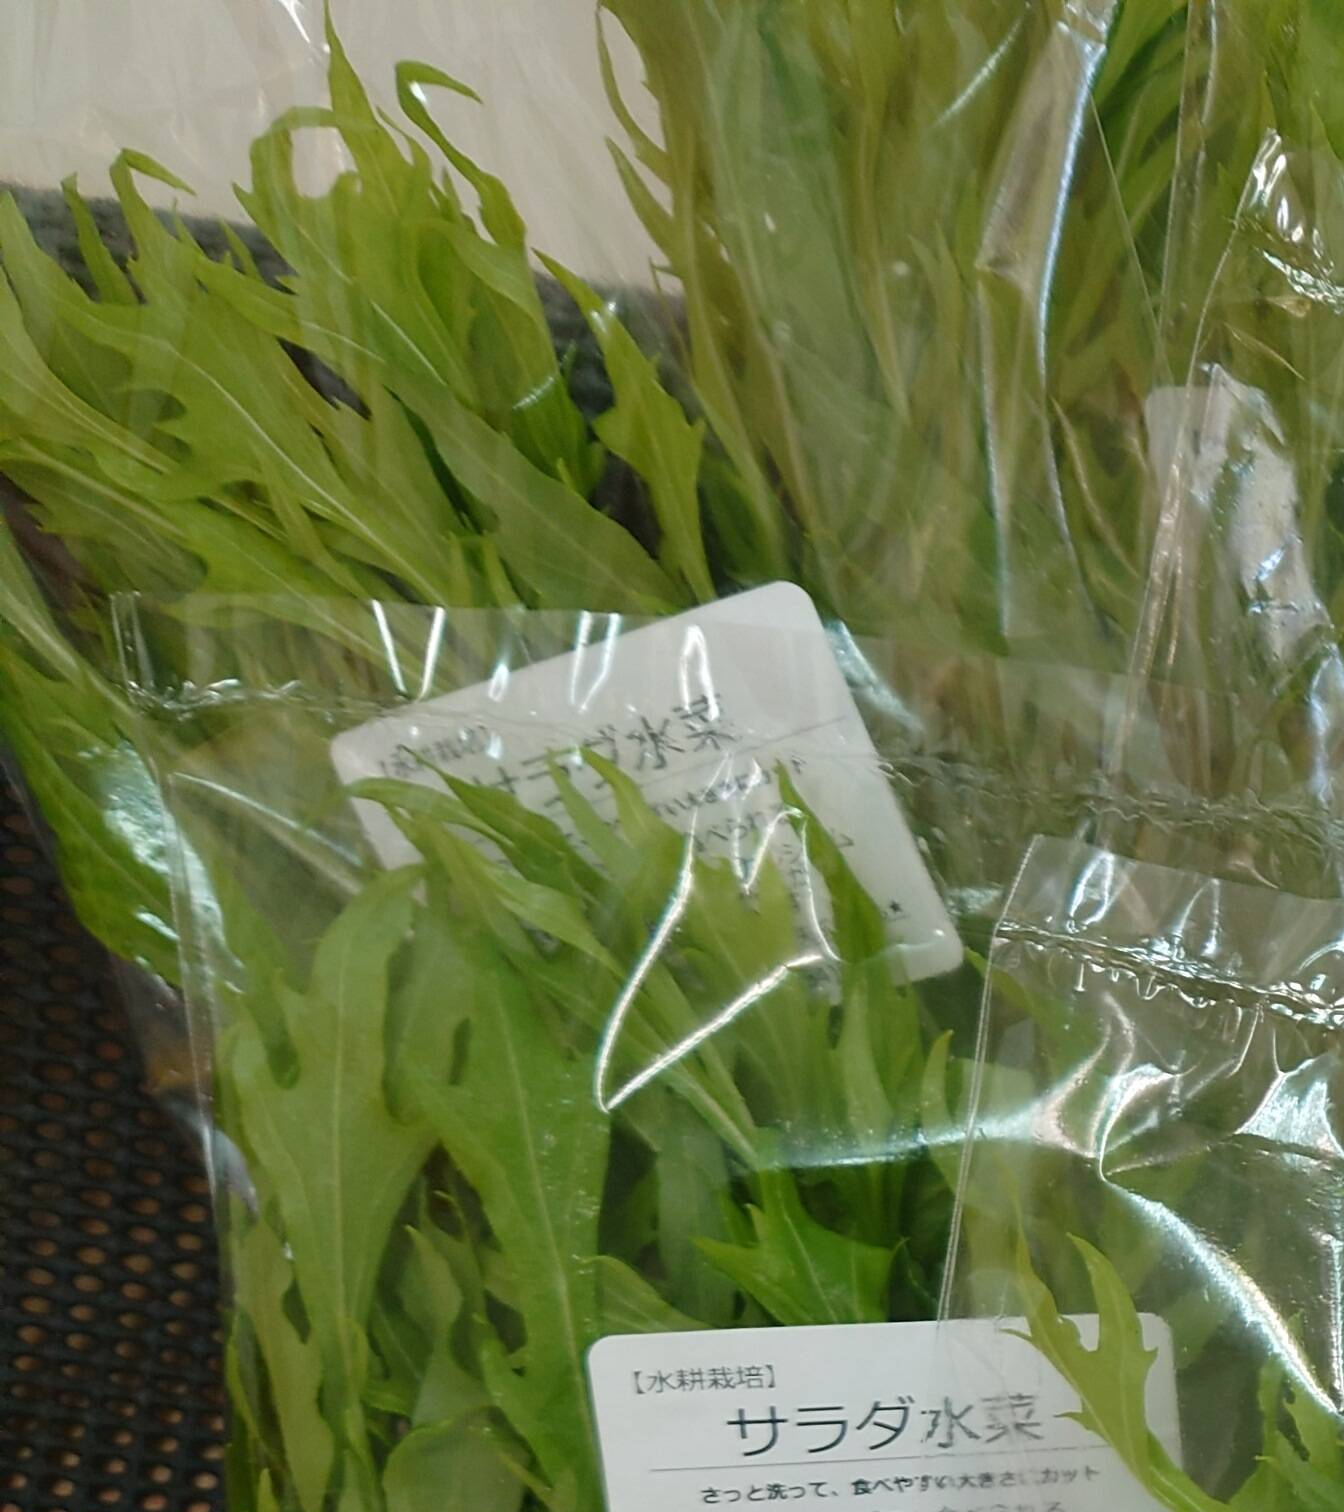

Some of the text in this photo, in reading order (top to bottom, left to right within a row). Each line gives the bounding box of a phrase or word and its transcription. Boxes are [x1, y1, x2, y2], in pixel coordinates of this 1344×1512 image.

[633, 1364, 778, 1395] 【水耕栽培】
[726, 1392, 1046, 1458] サラダ水菜
